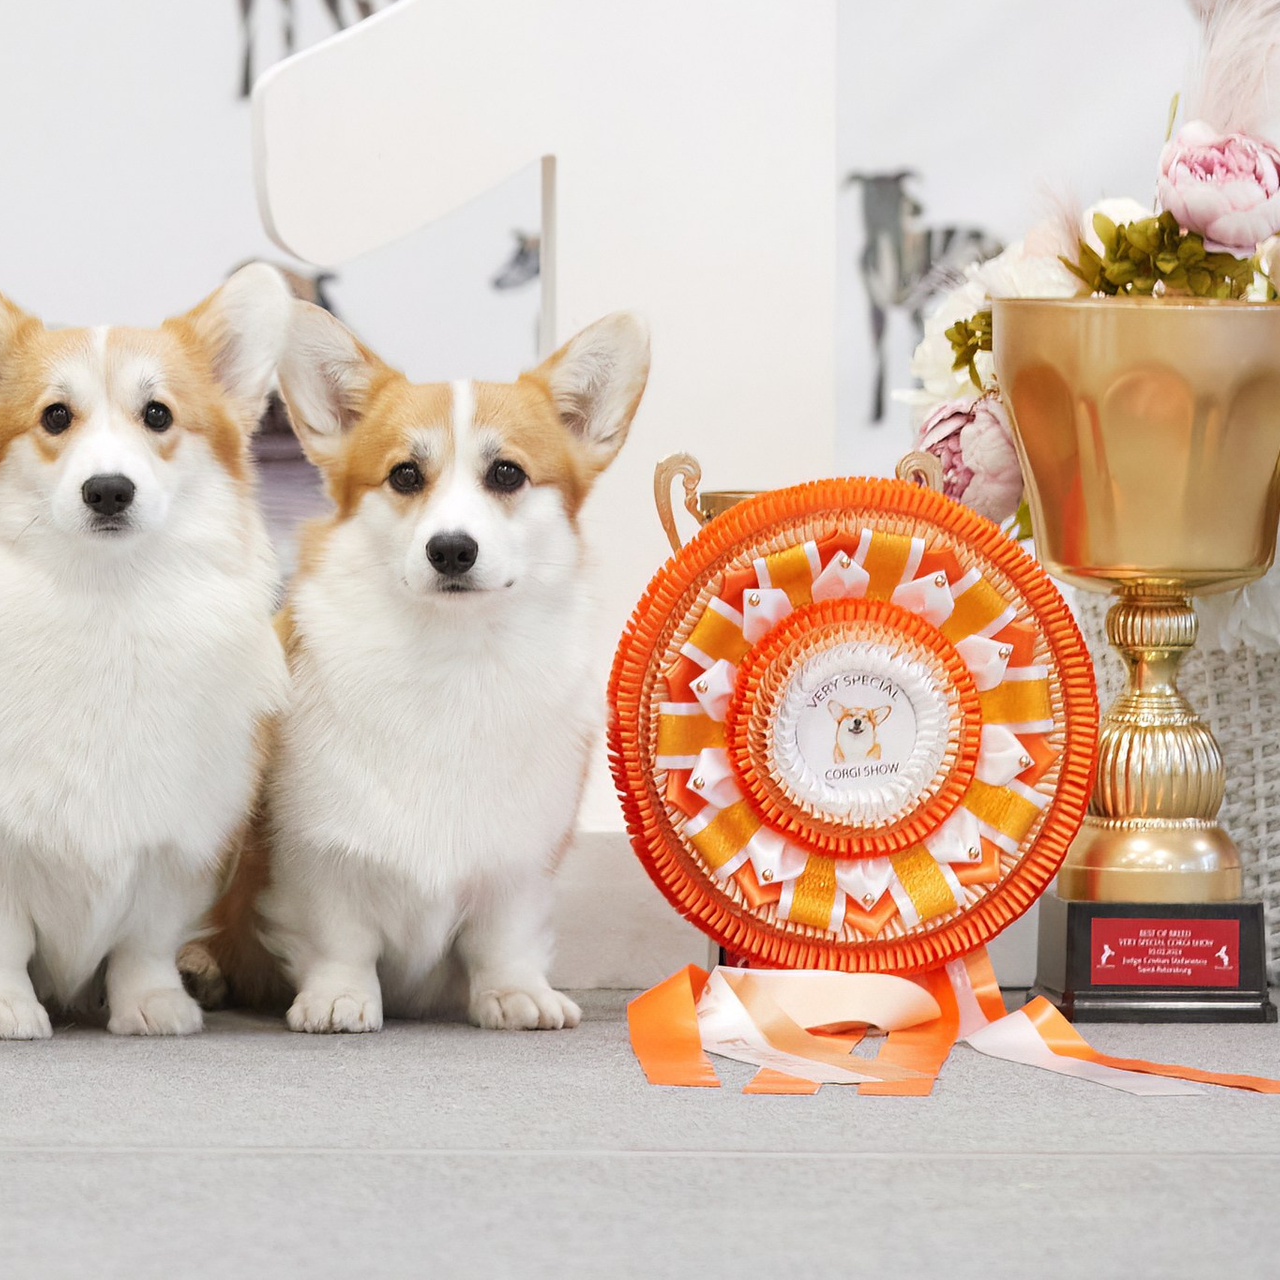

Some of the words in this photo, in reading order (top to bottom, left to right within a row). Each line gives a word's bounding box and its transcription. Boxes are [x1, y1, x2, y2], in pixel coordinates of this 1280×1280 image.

[806, 679, 840, 708] VERY
[843, 675, 900, 703] SPECIAL
[825, 768, 861, 780] CORGI
[863, 762, 899, 777] SHOW
[1139, 929, 1156, 937] BEST
[1156, 929, 1168, 937] OF
[1168, 929, 1192, 937] BREED
[1119, 938, 1137, 946] VERY
[1138, 938, 1166, 946] SPECIAL
[1167, 938, 1191, 947] CORGI
[1191, 939, 1215, 947] SHOW
